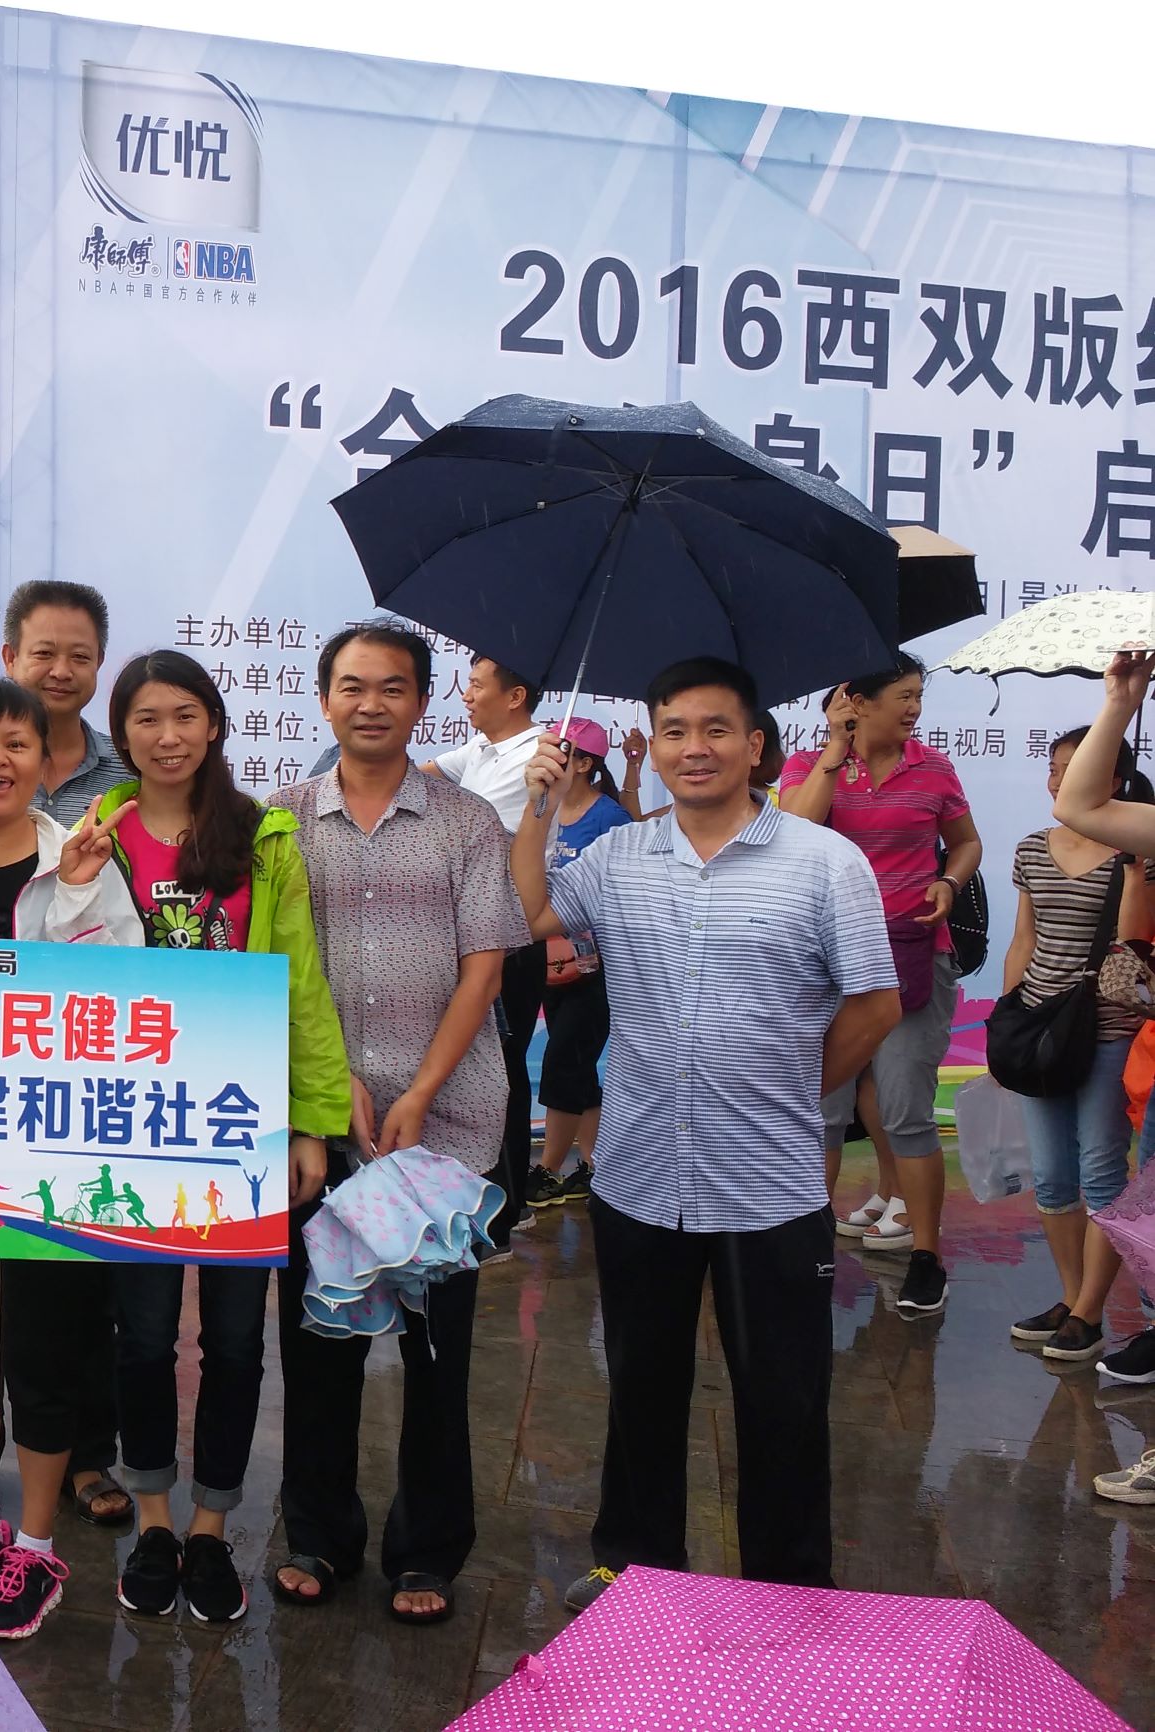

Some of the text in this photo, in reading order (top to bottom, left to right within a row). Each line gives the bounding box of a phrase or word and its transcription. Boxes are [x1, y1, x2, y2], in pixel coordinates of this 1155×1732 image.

[116, 113, 232, 183] 优悦
[195, 241, 257, 283] NBA
[78, 278, 258, 307] NBA中国官方合作伙伴
